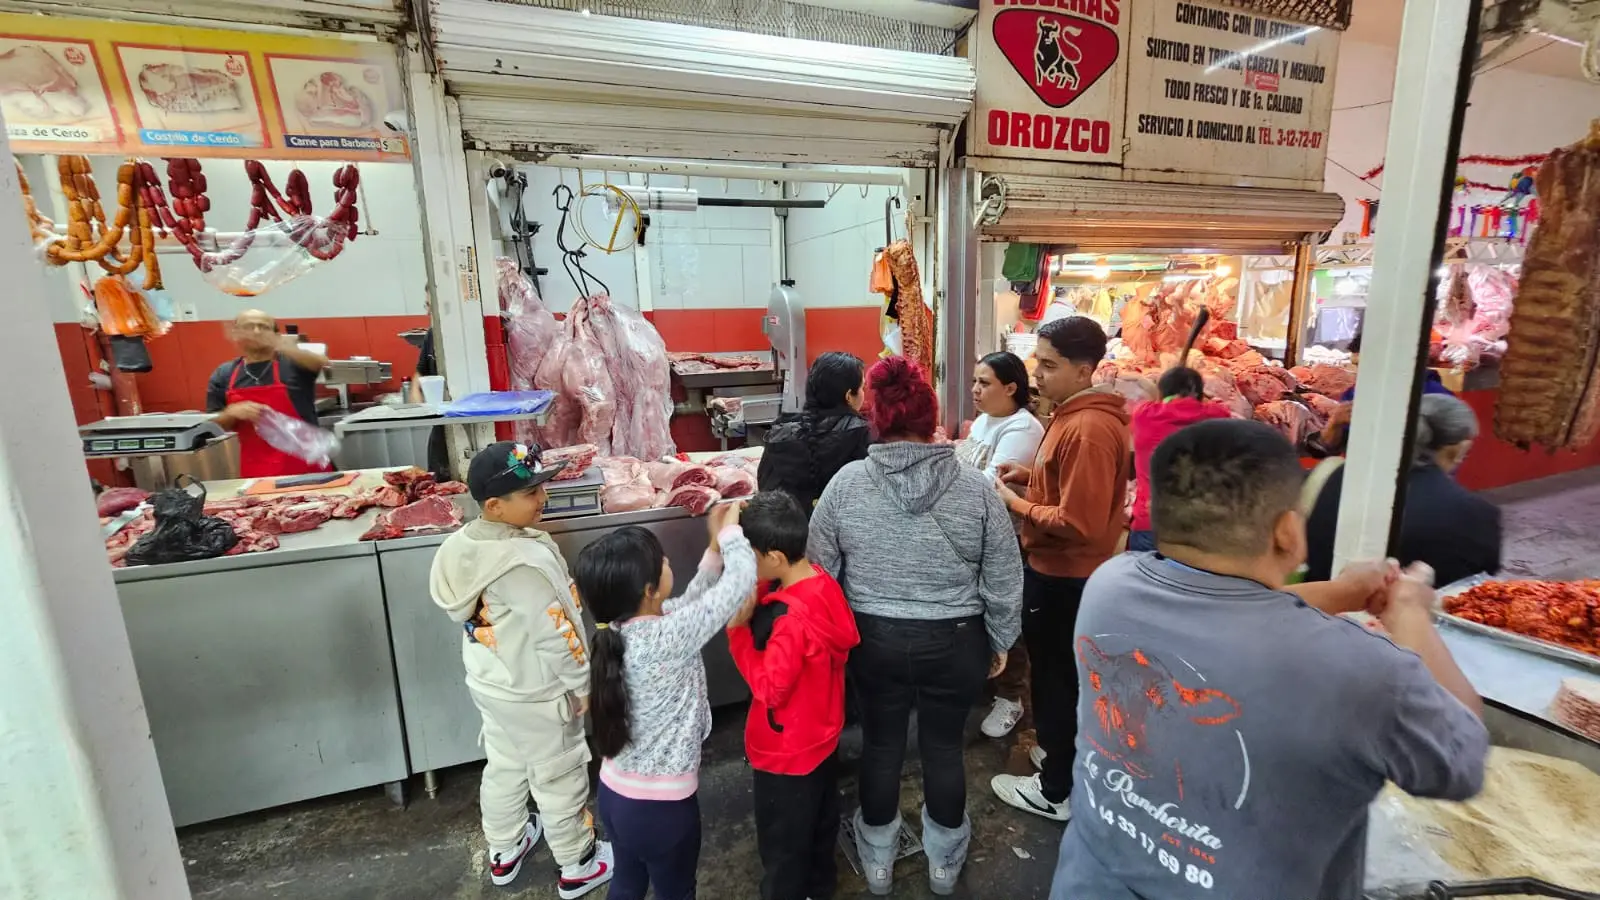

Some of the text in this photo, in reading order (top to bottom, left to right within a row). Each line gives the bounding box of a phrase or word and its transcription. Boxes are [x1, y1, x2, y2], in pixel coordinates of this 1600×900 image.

[1175, 3, 1230, 32] CONTAMOS
[1232, 13, 1251, 35] CON
[1254, 18, 1268, 37] UN
[1146, 37, 1189, 63] SURTIDO
[1193, 45, 1204, 65] EN
[1246, 54, 1279, 75] CABEZA
[1281, 60, 1288, 78] Y
[1290, 62, 1325, 84] MENUDO
[1165, 79, 1189, 100] TODO
[1193, 83, 1228, 106] FRESCO
[1231, 88, 1238, 107] Y
[1240, 90, 1250, 109] DE
[1266, 94, 1303, 114] CALIDAD
[32, 127, 48, 137] de
[52, 127, 89, 138] Cerdo
[146, 130, 240, 144] Costilla de Cerdo
[290, 137, 381, 149] Carne para Barbacoa
[988, 109, 1110, 154] OROZCO
[1138, 114, 1184, 137] SERVICIO
[1186, 120, 1193, 138] A
[1197, 120, 1243, 143] DOMICILIO
[1245, 127, 1255, 144] AL
[1258, 127, 1274, 146] TEL.
[1118, 815, 1136, 839] 33
[1140, 832, 1155, 854] 17
[1158, 848, 1180, 874] 69
[1185, 864, 1213, 889] 80
